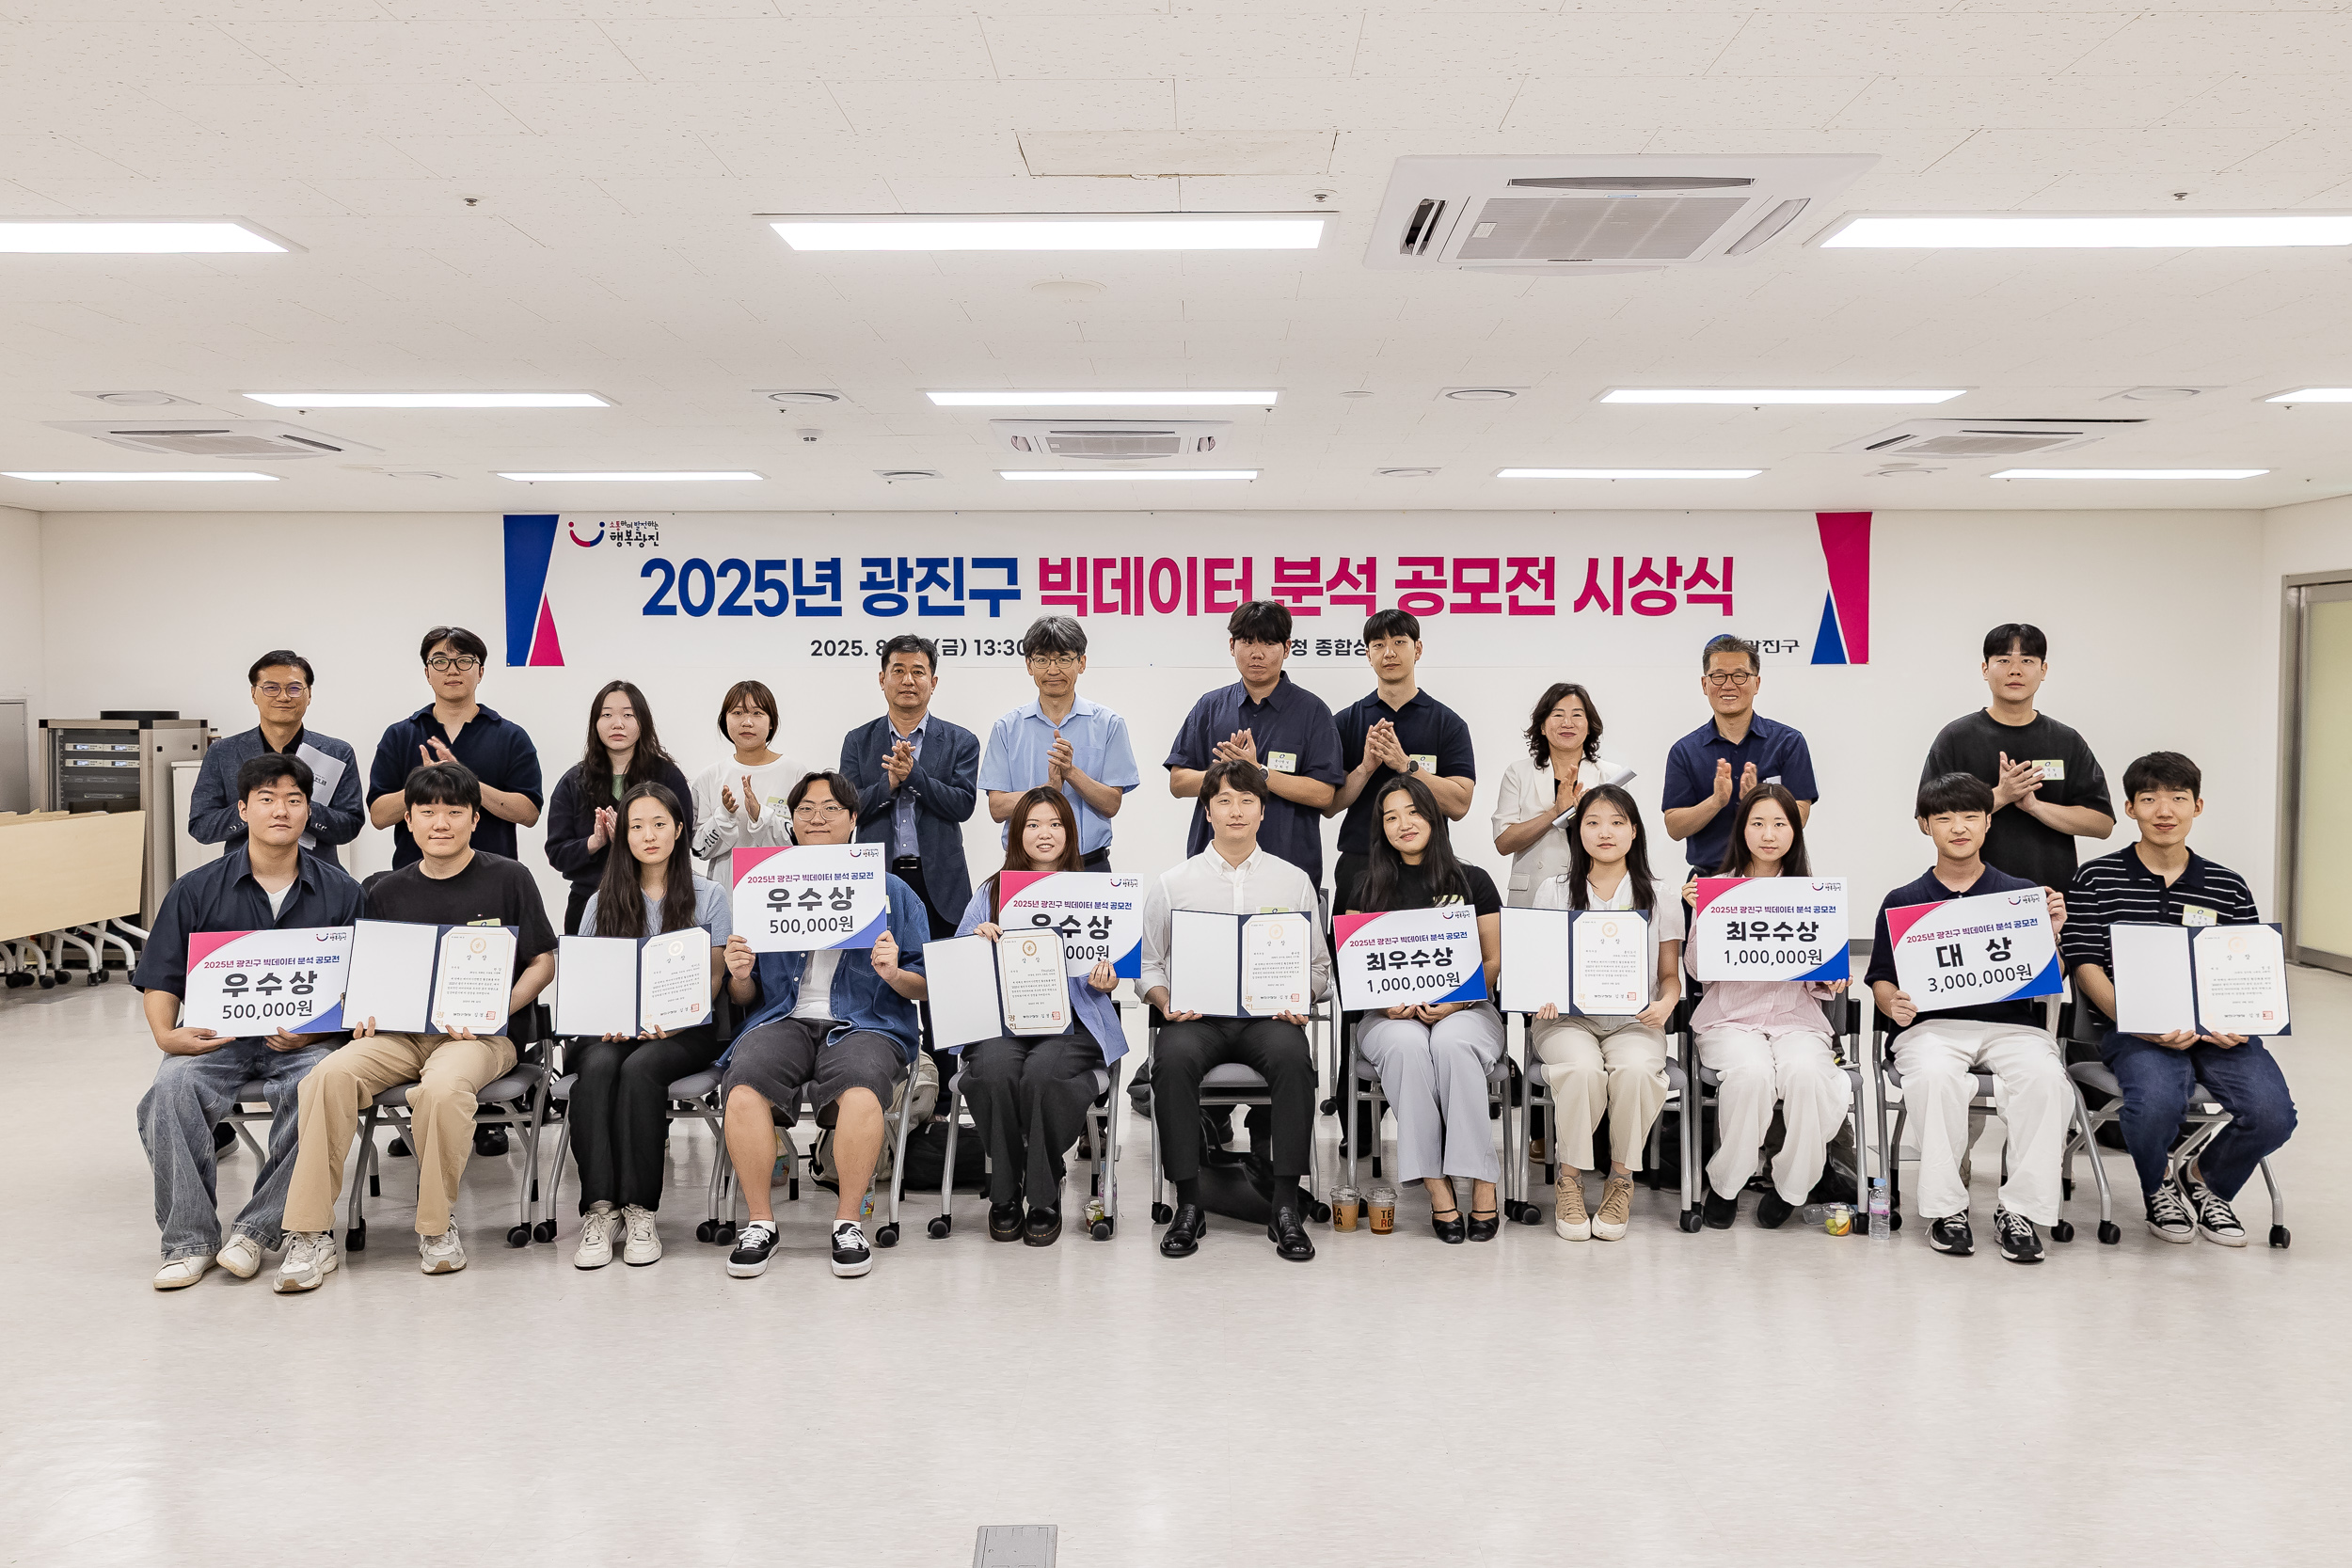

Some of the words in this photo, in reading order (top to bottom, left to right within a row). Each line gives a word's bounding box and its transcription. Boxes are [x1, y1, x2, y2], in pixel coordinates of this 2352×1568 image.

[610, 530, 660, 547] 행복광진
[640, 557, 842, 616] 2025년
[859, 557, 1021, 617] 광진구
[1039, 557, 1252, 616] 빅데이터
[1271, 557, 1377, 616] 분석
[1394, 557, 1557, 616] 공모전
[1573, 557, 1734, 616] 시상식
[810, 640, 868, 657] 2025.
[747, 876, 775, 884] 2025년
[778, 874, 801, 883] 광진구
[803, 873, 833, 881] 빅데이터
[834, 872, 850, 880] 분석
[851, 871, 874, 879] 공모전
[767, 886, 855, 912] 우수상
[1041, 900, 1062, 909] 광진구
[1064, 900, 1093, 909] 빅데이터
[1094, 901, 1108, 910] 분석
[1110, 901, 1132, 910] 공모전
[770, 915, 854, 935] 500,000원
[1726, 921, 1820, 942] 최우수상
[1906, 933, 1935, 943] 2025년
[1936, 928, 1962, 940] 광진구
[1963, 925, 1994, 935] 빅데이터
[1995, 921, 2012, 931] 분석
[2013, 918, 2039, 928] 공모전
[1350, 939, 1375, 947] 2025년
[1377, 937, 1399, 945] 광진구
[1400, 934, 1429, 943] 빅데이터
[1430, 933, 1445, 942] 분석
[1446, 931, 1468, 940] 공모전
[204, 959, 234, 969] 2025년
[236, 958, 262, 968] 광진구
[263, 957, 296, 966] 빅데이터
[297, 956, 314, 965] 분석
[315, 955, 341, 964] 공모전
[1366, 946, 1454, 971] 최우수상
[1724, 949, 1822, 966] 1,000,000원
[222, 971, 318, 998] 우수상
[1367, 971, 1461, 994] 1,000,000원
[1928, 963, 2033, 993] 3,000,000원
[222, 1000, 313, 1021] 500,000원
